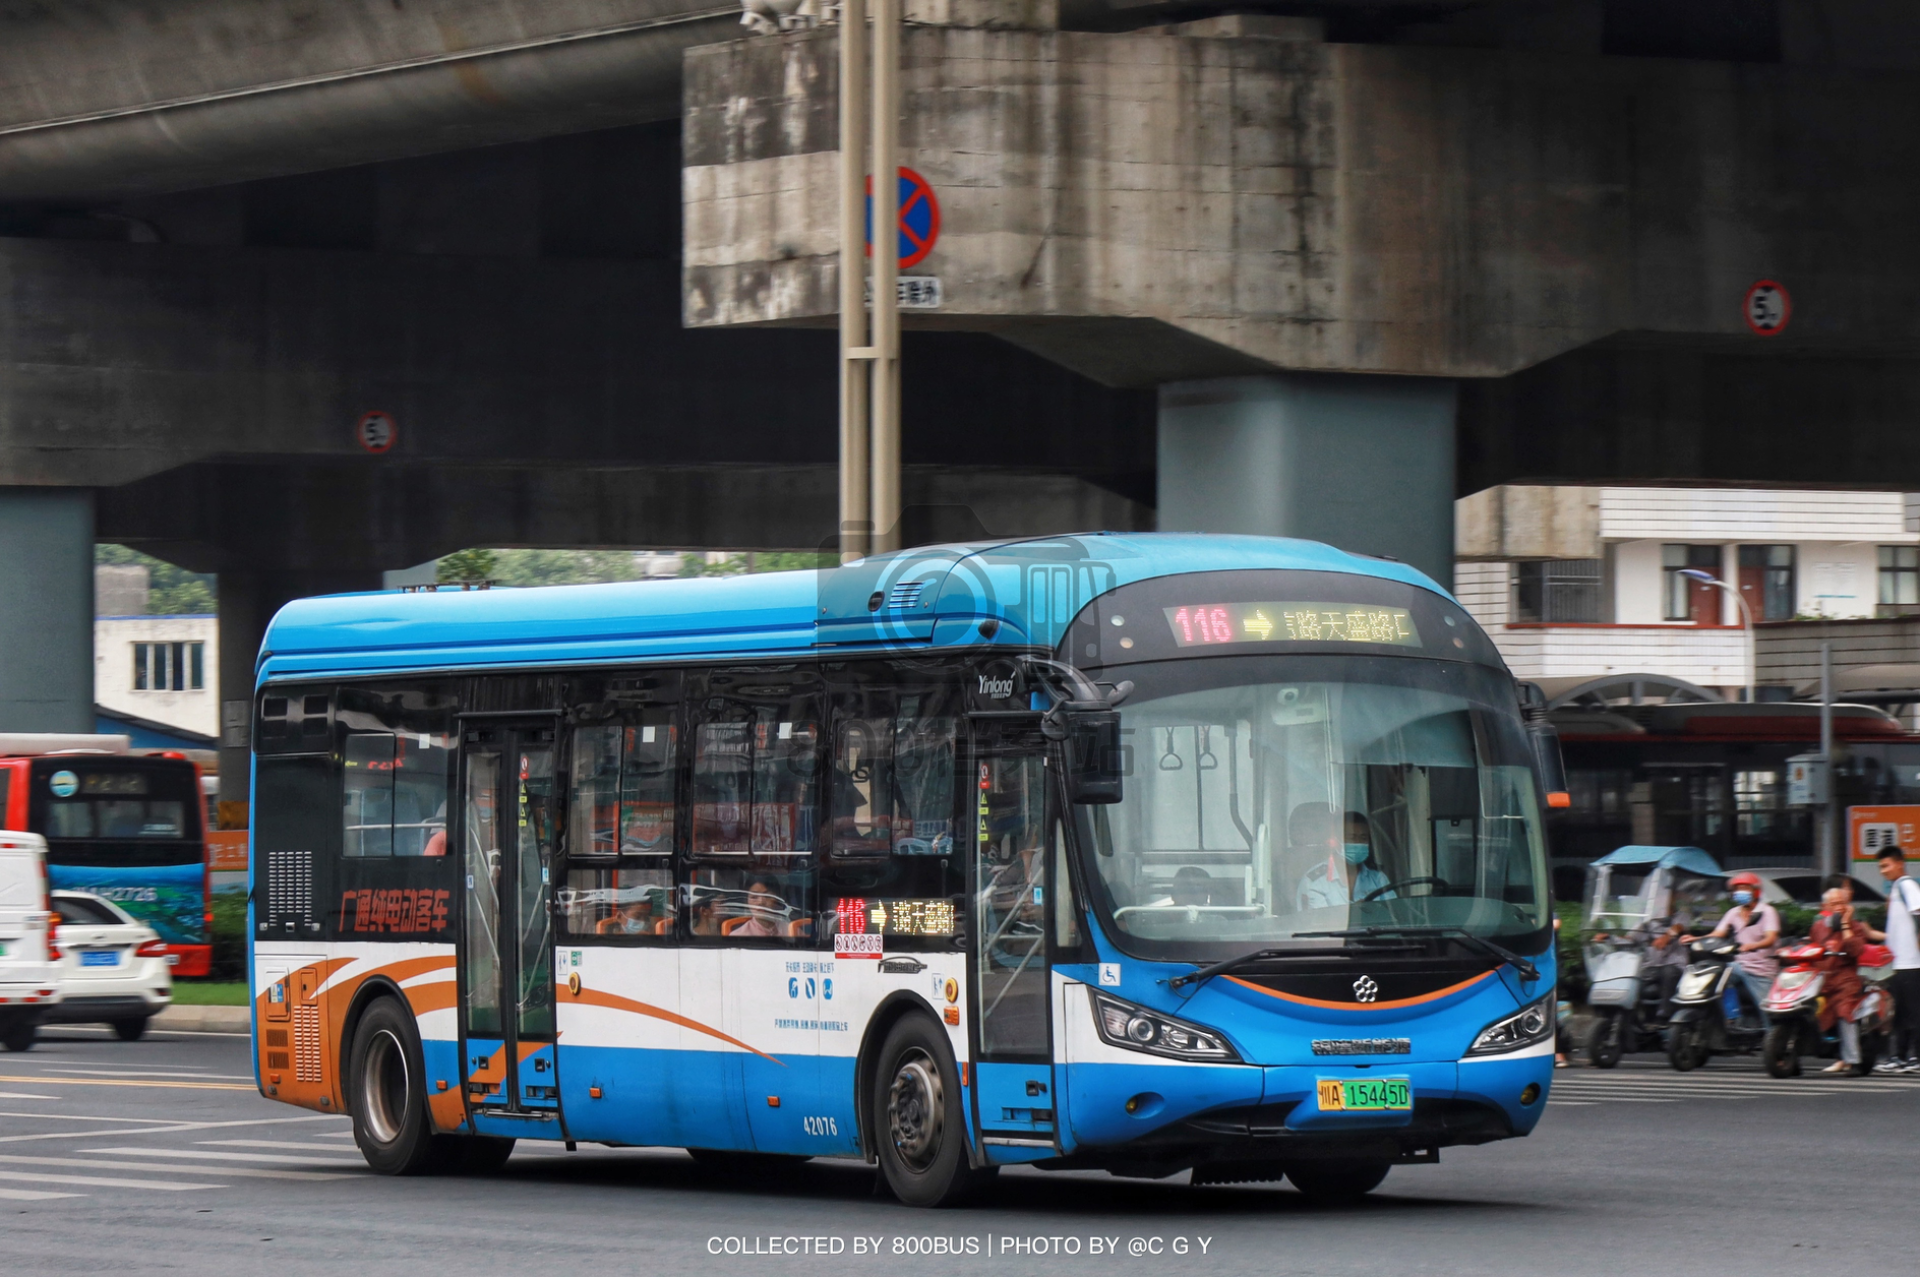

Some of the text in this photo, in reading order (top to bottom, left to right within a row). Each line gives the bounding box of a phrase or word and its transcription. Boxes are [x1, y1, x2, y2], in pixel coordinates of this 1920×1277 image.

[1175, 608, 1231, 642] 116
[339, 888, 450, 933] 广通纯电动客车
[1349, 1084, 1409, 1106] 15445D
[803, 1115, 838, 1137] 42076
